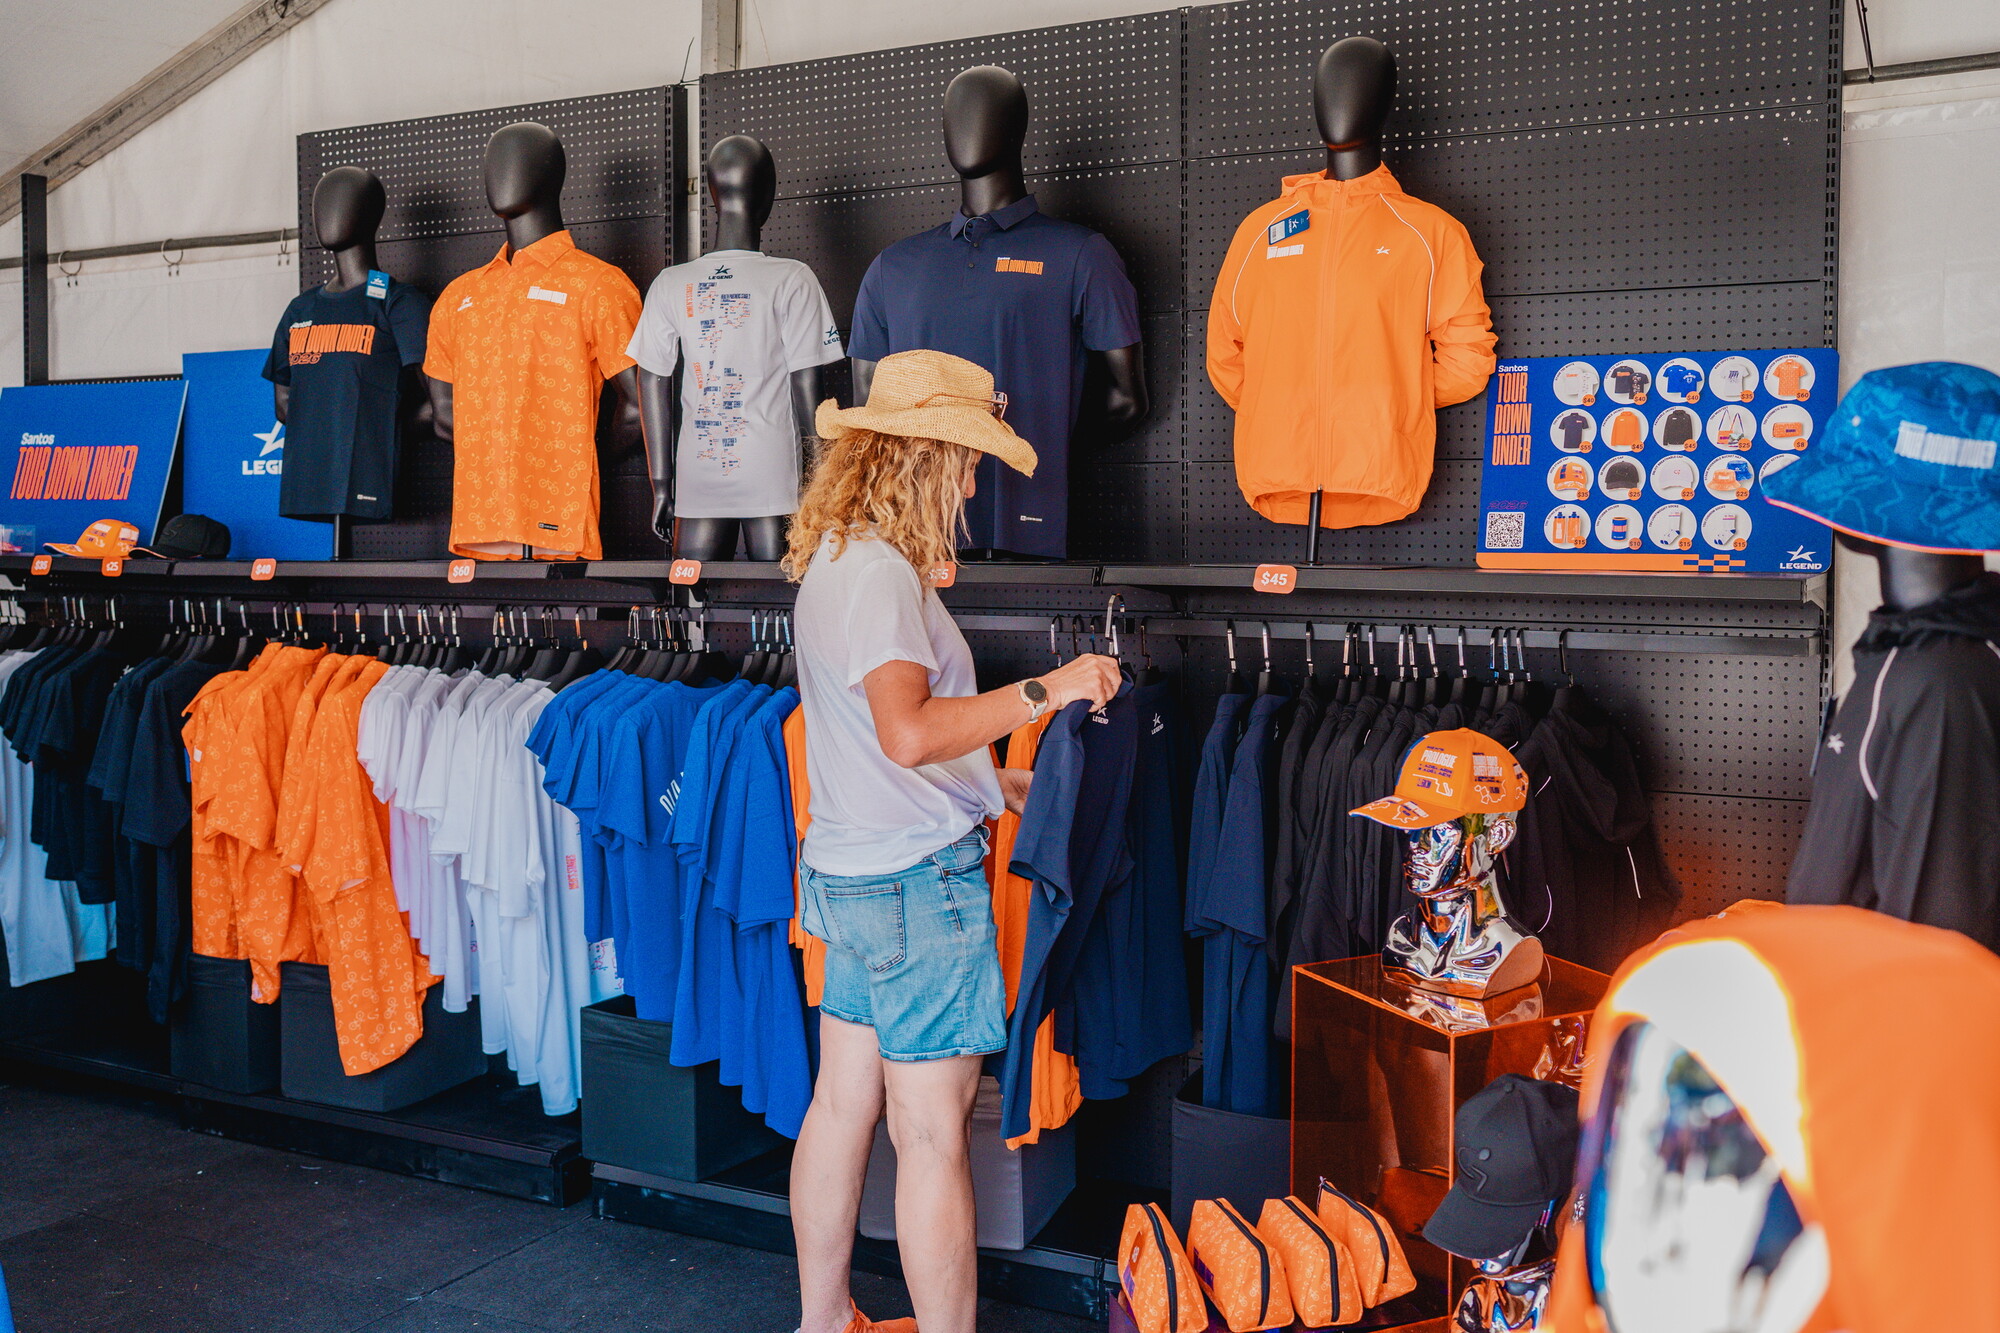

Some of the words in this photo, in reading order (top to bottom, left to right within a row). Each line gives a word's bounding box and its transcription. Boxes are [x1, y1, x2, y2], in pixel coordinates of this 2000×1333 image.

[1498, 364, 1529, 373] Santos
[1497, 372, 1528, 403] TOUR
[1493, 403, 1532, 435] DOWN
[20, 432, 55, 446] Santos
[1491, 434, 1532, 466] UNDER
[9, 446, 52, 500] TOUR
[43, 446, 95, 500] DOWN
[85, 445, 139, 500] UNDER
[242, 460, 283, 475] LEG
[1487, 500, 1529, 510] 2026
[452, 565, 470, 577] $60
[674, 565, 695, 578] $40
[1779, 562, 1823, 570] LEGEND
[1261, 571, 1288, 586] $45
[1092, 715, 1109, 725] LEGEND
[1420, 749, 1458, 769] PROLOGUE
